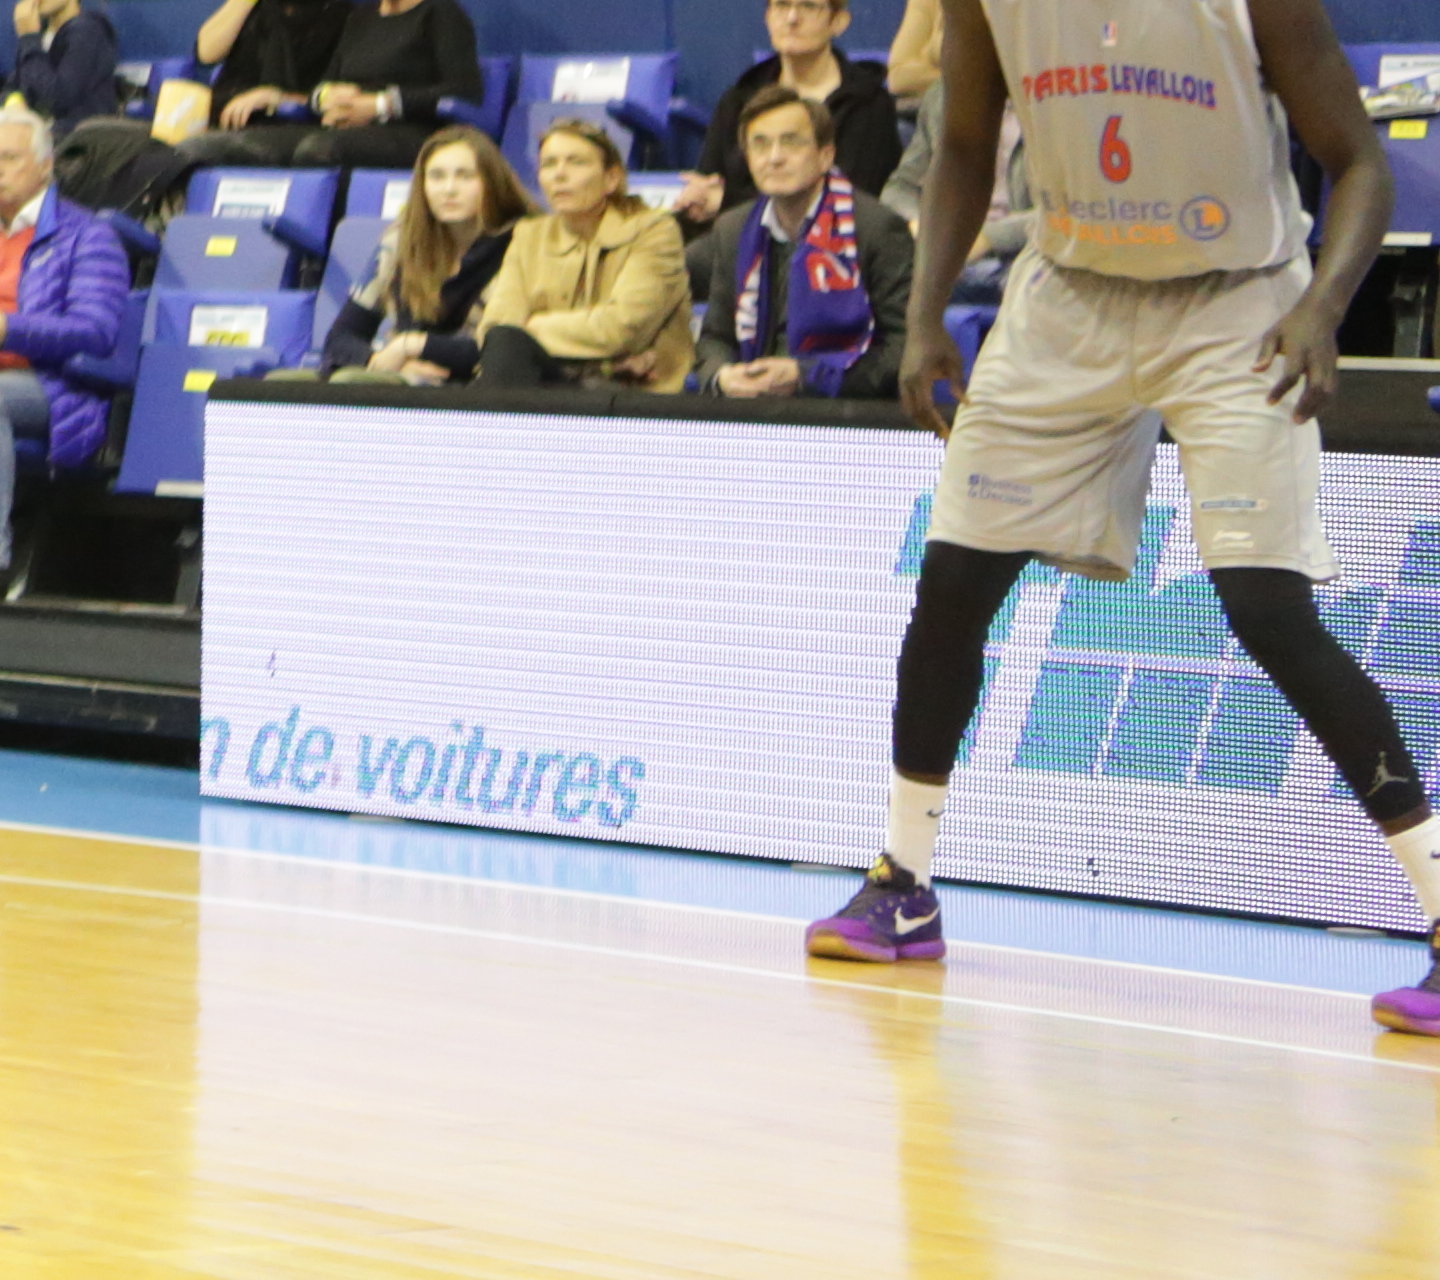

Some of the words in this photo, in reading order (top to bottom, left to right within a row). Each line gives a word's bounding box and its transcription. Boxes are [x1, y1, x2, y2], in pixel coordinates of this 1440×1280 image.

[1111, 65, 1218, 110] LEVALLOIS
[1098, 115, 1133, 183] 6
[245, 704, 334, 793] de
[356, 719, 646, 828] voitures
